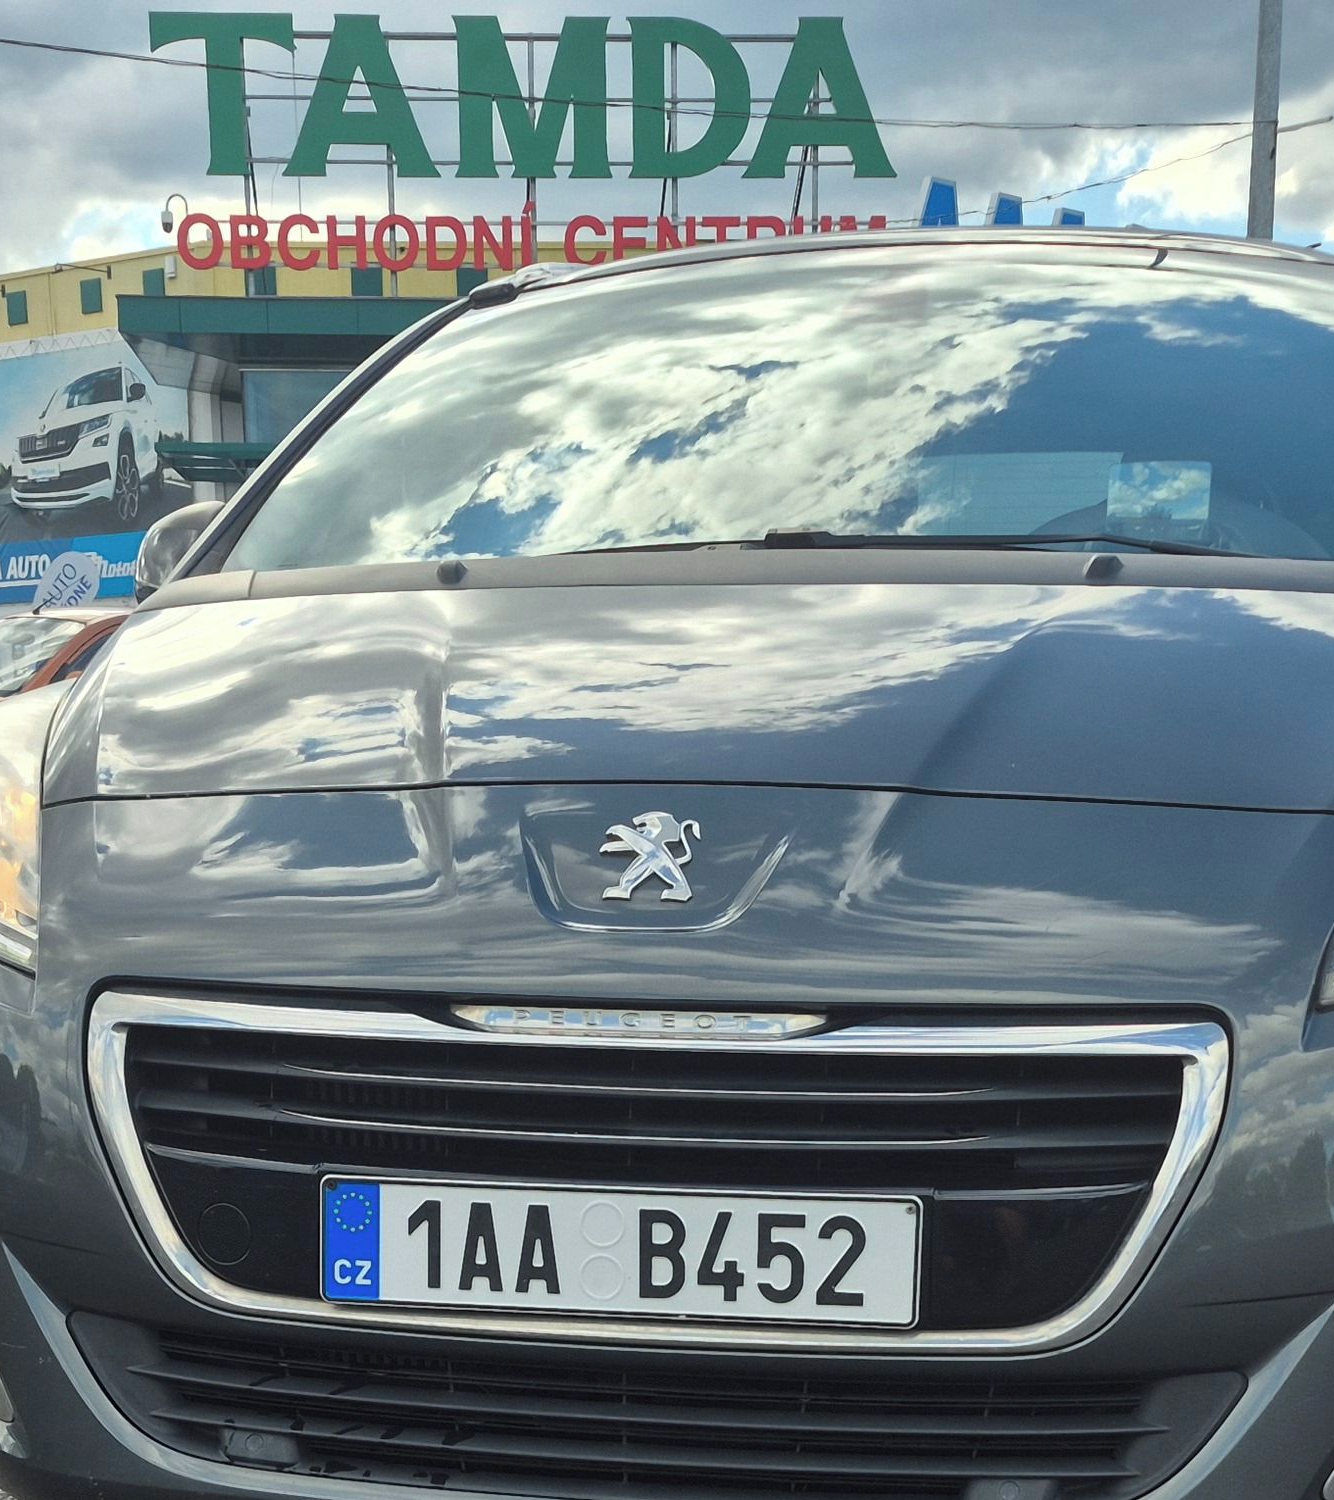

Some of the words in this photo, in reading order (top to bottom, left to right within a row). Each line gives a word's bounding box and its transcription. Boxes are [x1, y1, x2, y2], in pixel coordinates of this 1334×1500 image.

[148, 11, 898, 179] TAMDA
[176, 200, 536, 272] OBCHODNÍ
[563, 214, 887, 265] CENT
[6, 554, 52, 580] AUTO
[43, 563, 77, 608] AUTO
[512, 1009, 752, 1030] PEUGEOT
[333, 1258, 373, 1286] CZ
[407, 1200, 562, 1295] 1AA
[638, 1208, 867, 1307] B452
